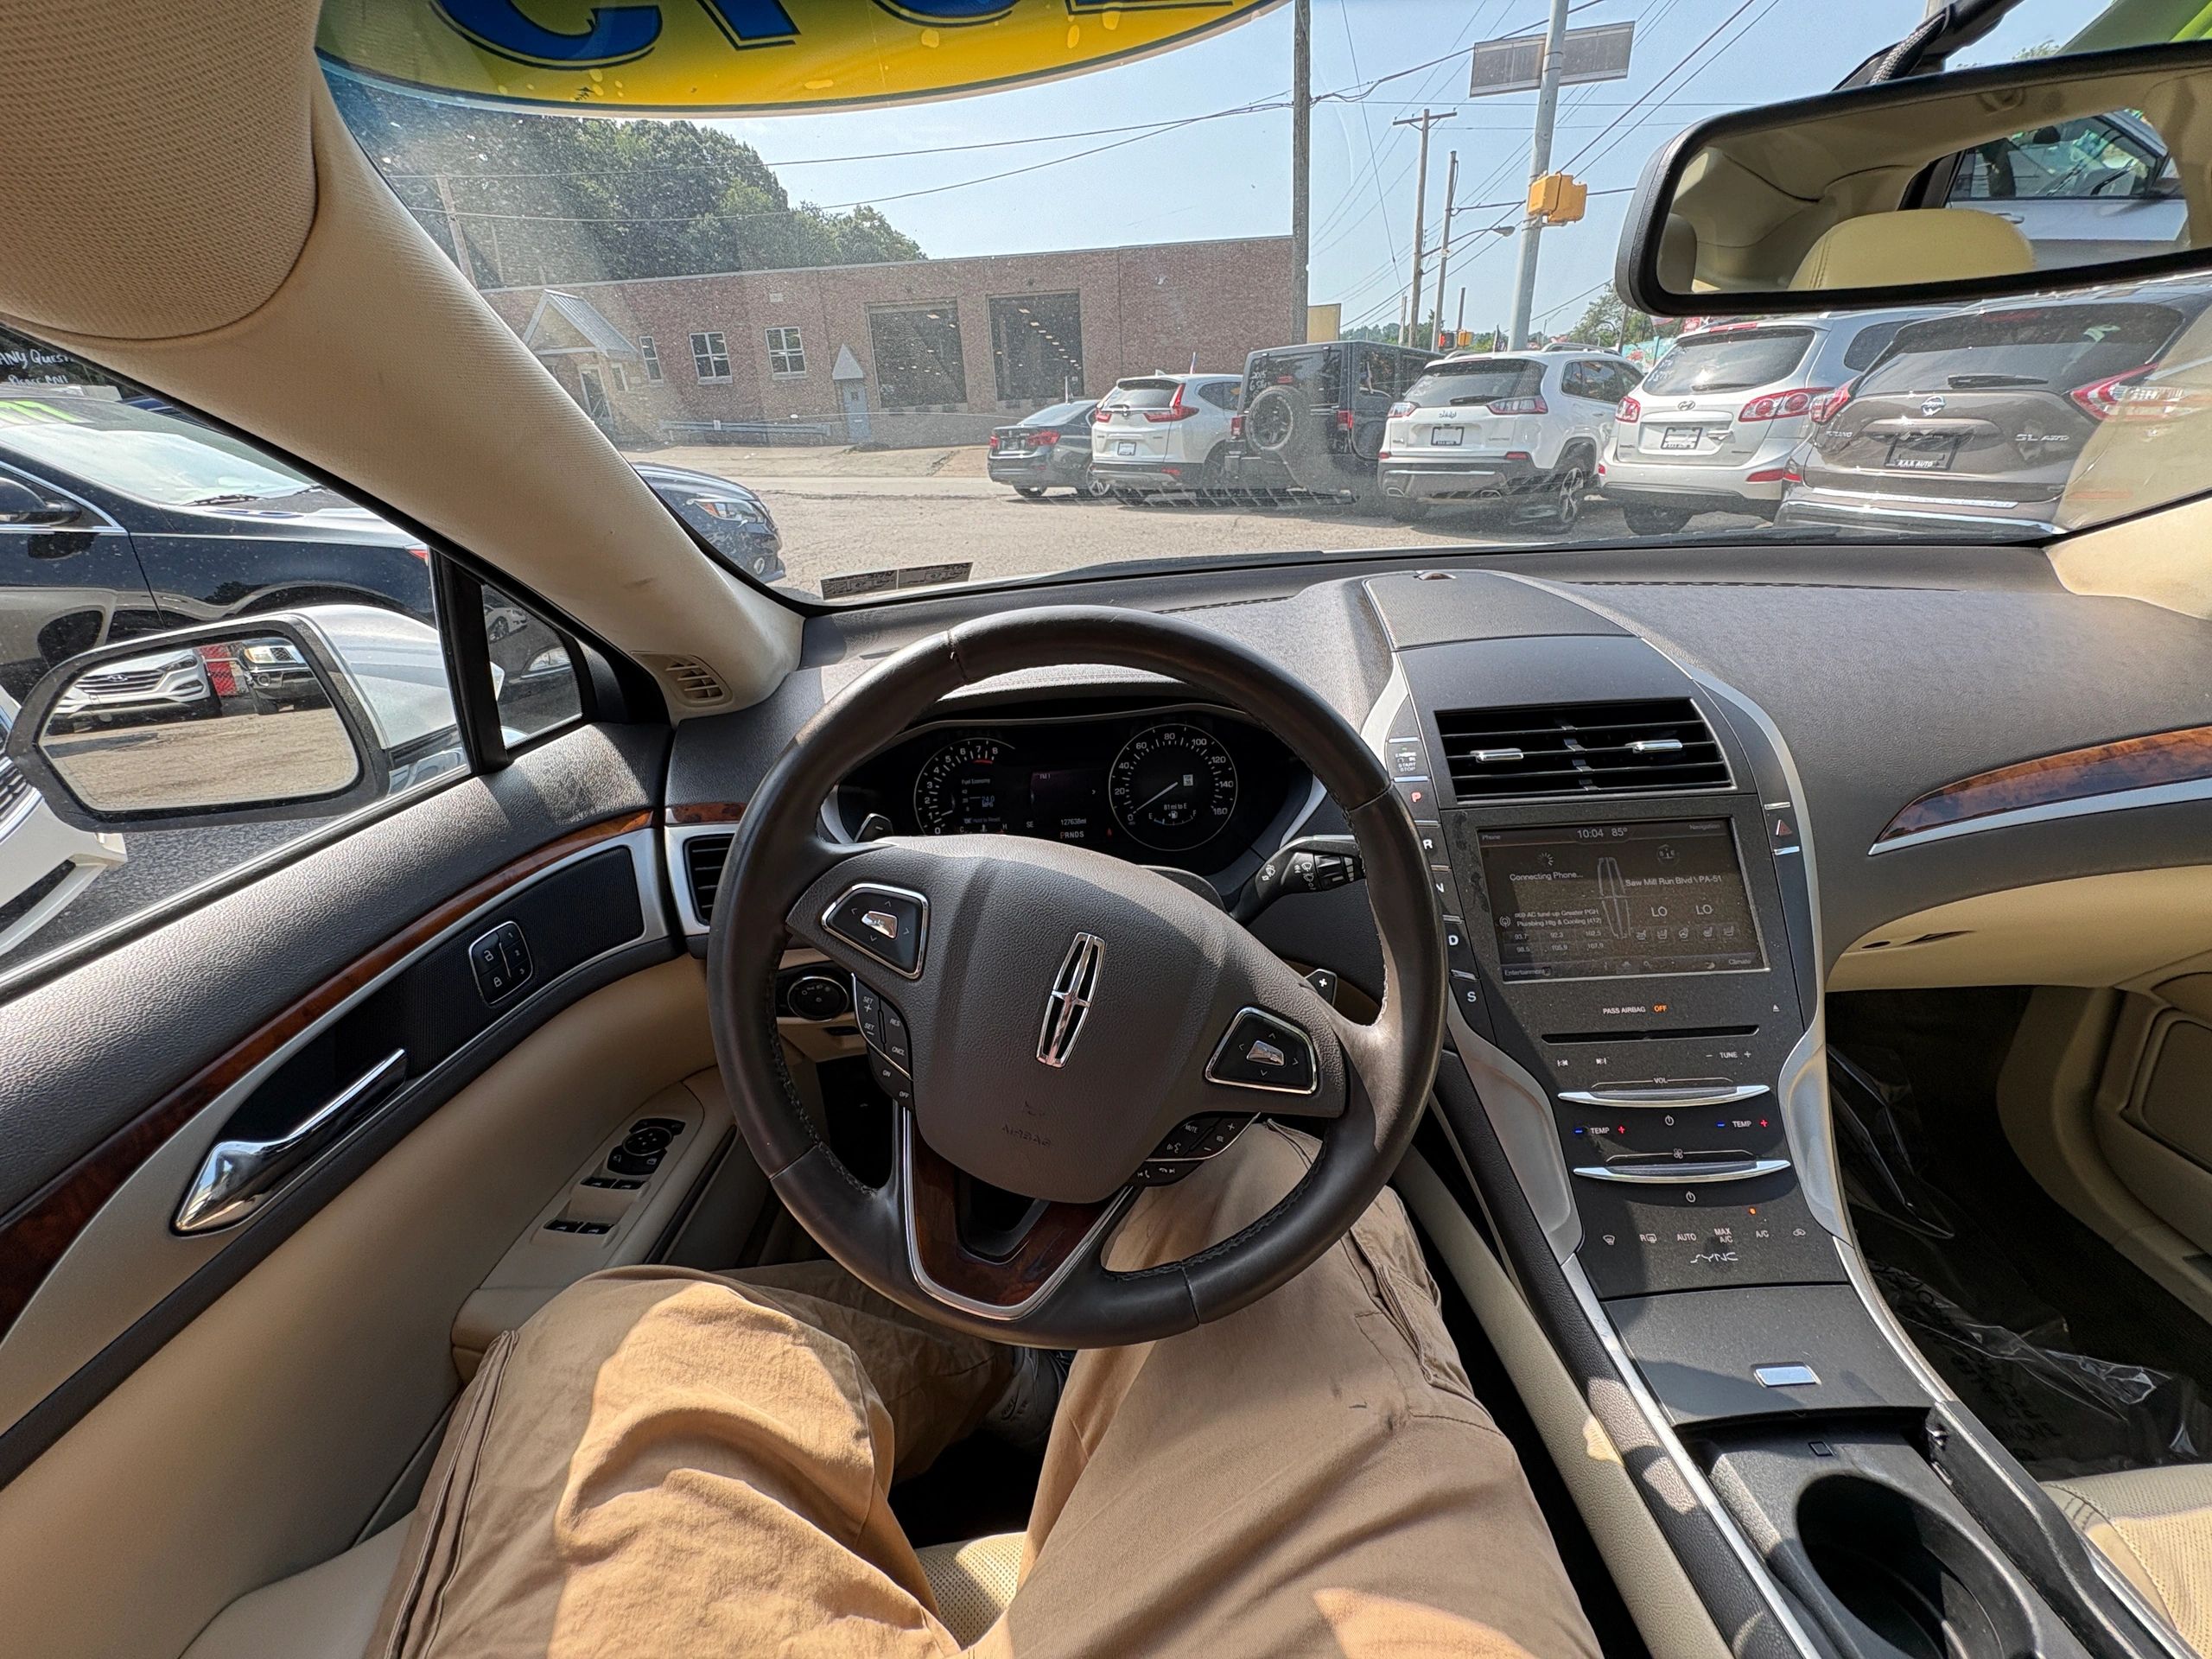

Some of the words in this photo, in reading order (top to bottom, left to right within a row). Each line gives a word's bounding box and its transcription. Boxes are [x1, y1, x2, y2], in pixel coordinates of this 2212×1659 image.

[976, 745, 982, 753] 7
[1135, 741, 1147, 750] 60
[1411, 791, 1421, 803] P
[1577, 829, 1604, 839] 10:04
[1422, 838, 1433, 849] R
[1510, 873, 1552, 882] Connecting
[1624, 879, 1643, 887] Saw
[1658, 877, 1675, 886] Run
[1675, 876, 1694, 885] Blvd
[1699, 874, 1722, 883] PA-51
[1651, 906, 1668, 918] LO
[1695, 904, 1713, 915] LO
[1448, 935, 1459, 945] D
[862, 996, 874, 1005] SET
[1467, 991, 1477, 1002] S
[1621, 1006, 1646, 1014] AIRBAG
[864, 1022, 875, 1031] SET
[889, 1018, 901, 1027] RES
[891, 1046, 906, 1056] CNCL
[899, 1090, 910, 1099] OFF
[1185, 1123, 1198, 1134] MUTE
[1732, 1120, 1752, 1128] TEMP
[1590, 1127, 1611, 1135] TEMP
[1713, 1227, 1732, 1236] MAX
[1755, 1230, 1770, 1238] A/C
[1676, 1233, 1697, 1242] AUTO
[1689, 1251, 1739, 1264] SYNC
